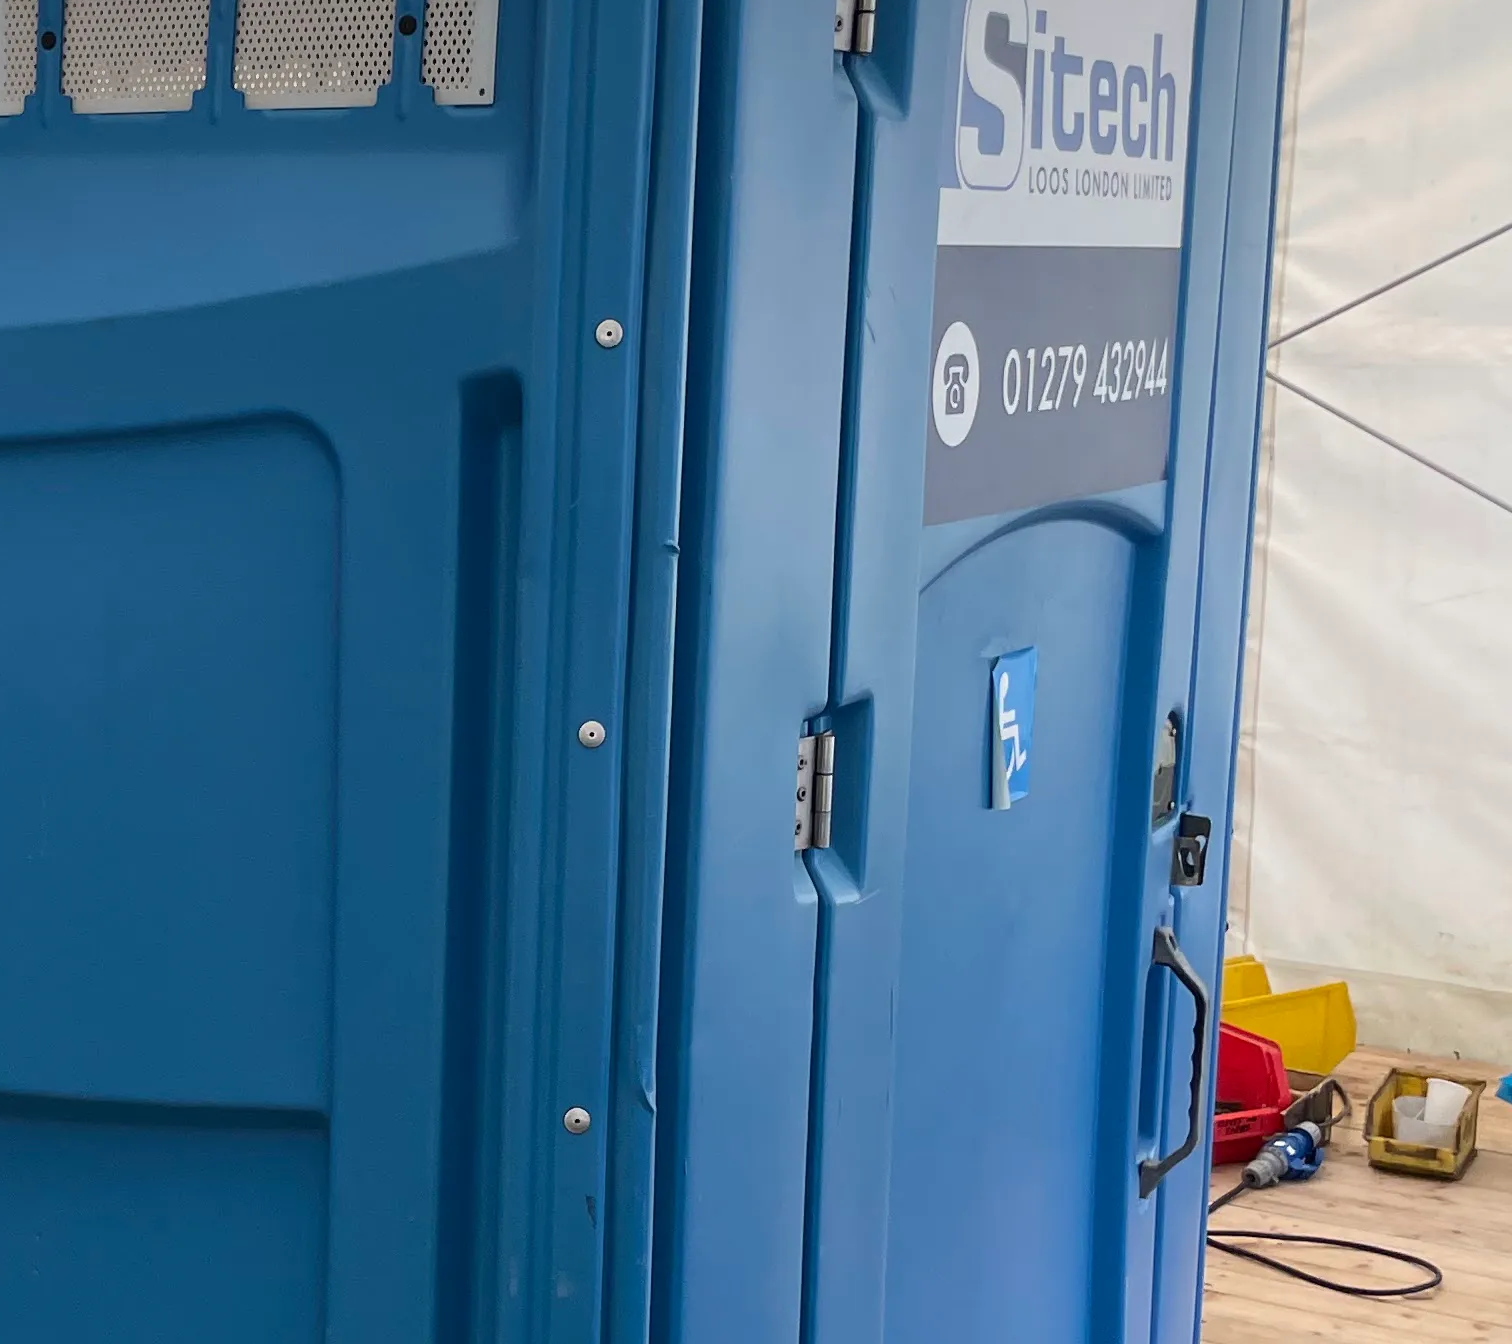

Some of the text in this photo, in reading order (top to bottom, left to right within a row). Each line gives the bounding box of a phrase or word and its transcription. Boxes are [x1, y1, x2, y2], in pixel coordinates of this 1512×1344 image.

[1028, 166, 1173, 201] LOOS LONDON LIMITED
[1002, 337, 1168, 415] 01279 432944
